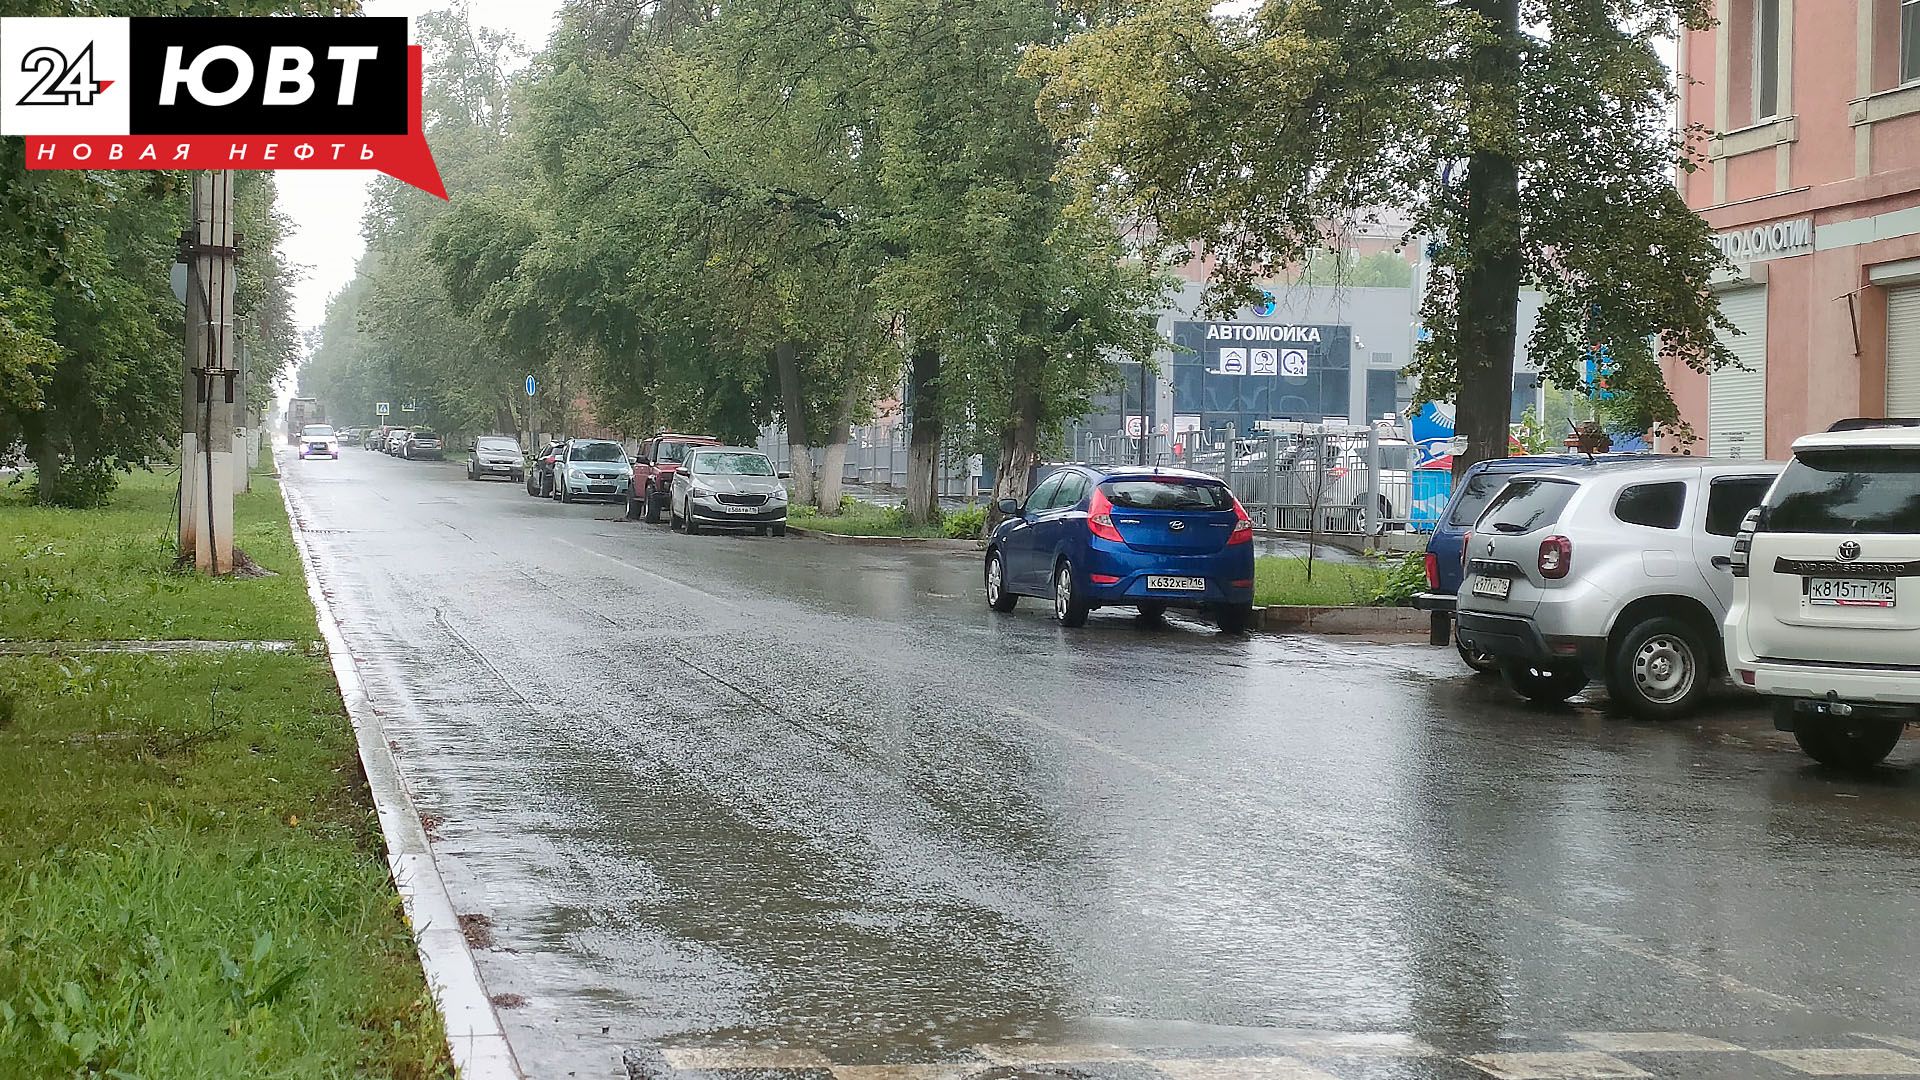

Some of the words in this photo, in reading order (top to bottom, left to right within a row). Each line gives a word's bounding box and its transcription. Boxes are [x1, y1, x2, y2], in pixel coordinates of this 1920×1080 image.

[1720, 218, 1810, 257] ПОДОЛОГИИ
[1206, 323, 1321, 343] АВТОМОЙКА
[1293, 367, 1304, 375] 24
[1791, 562, 1817, 571] LAND
[1866, 564, 1905, 572] PRADO
